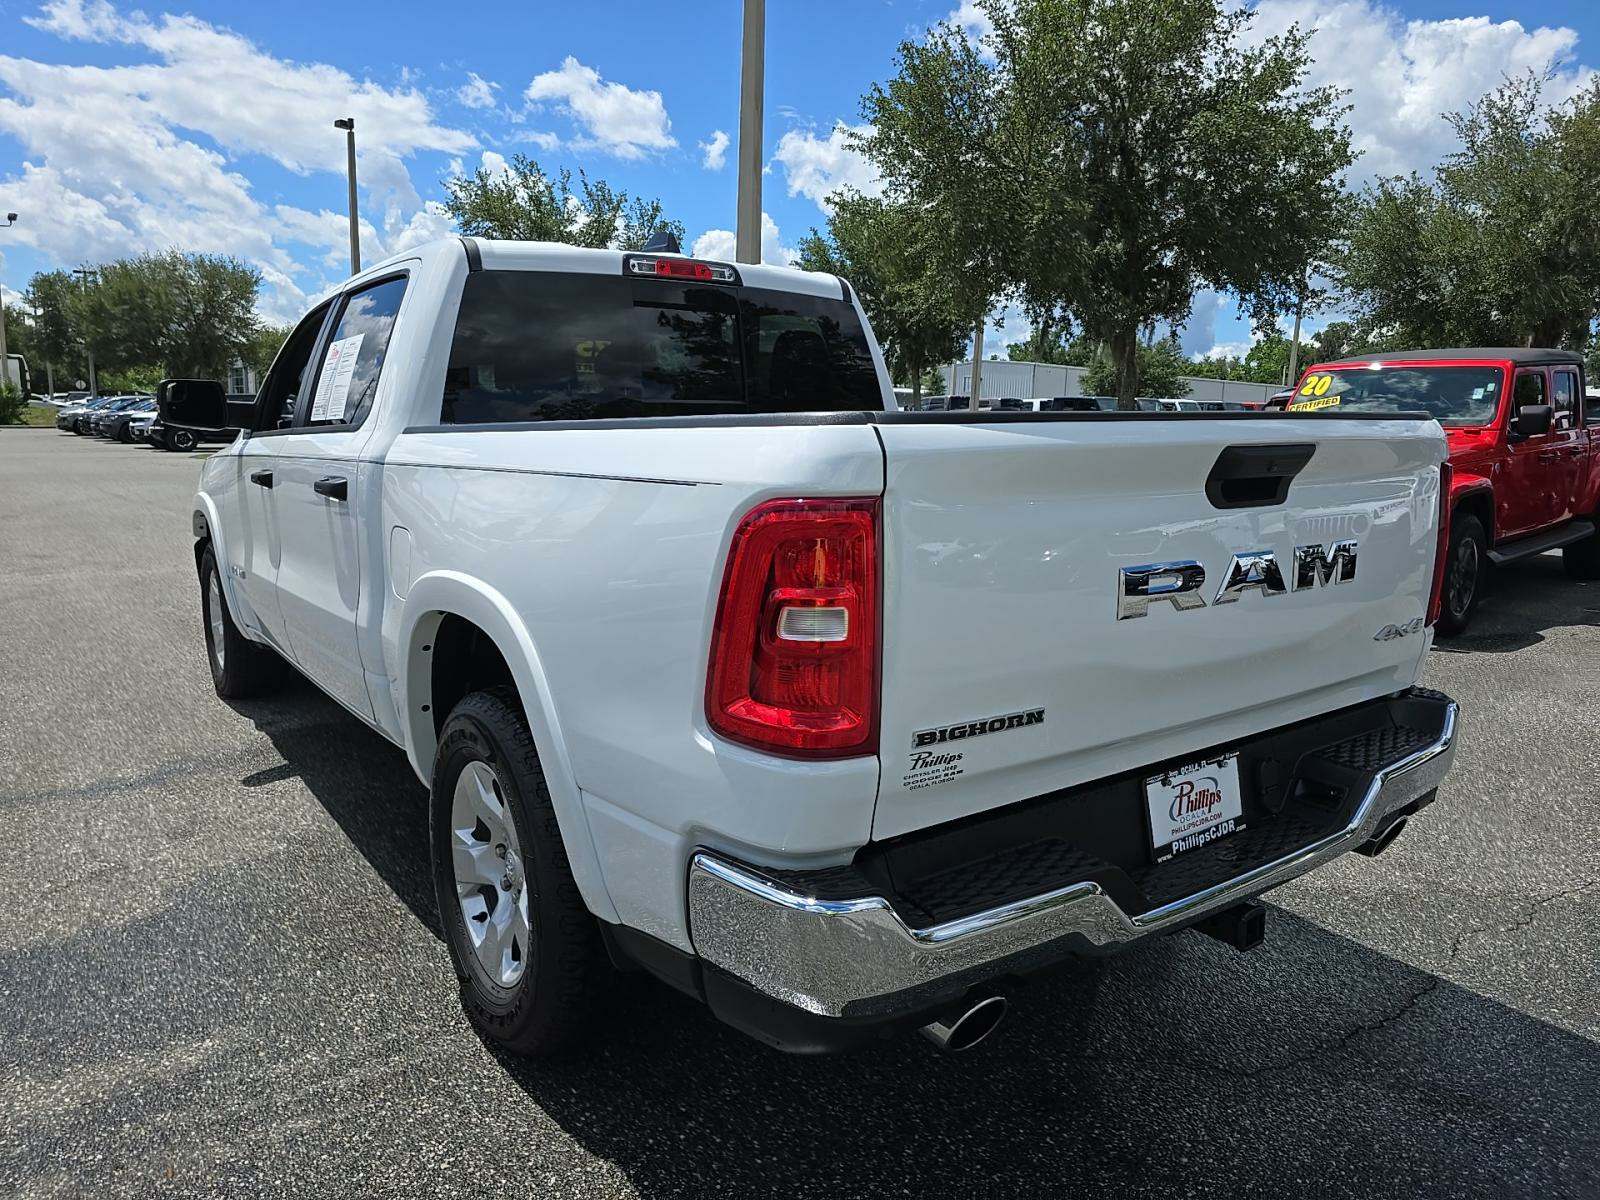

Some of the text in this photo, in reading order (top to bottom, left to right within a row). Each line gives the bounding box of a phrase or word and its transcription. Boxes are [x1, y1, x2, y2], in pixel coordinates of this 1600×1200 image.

[1301, 375, 1332, 396] 20
[1290, 397, 1338, 411] CERTIFIED
[1116, 538, 1358, 621] RAM
[912, 707, 1045, 749] BIGHORN
[909, 751, 964, 771] Phillips
[903, 768, 941, 780] CHRYSLER
[903, 769, 964, 787] DODGE RAM
[1171, 780, 1222, 817] Phillips
[1171, 812, 1223, 836] PHILLIPSCJDR.COM
[1180, 809, 1207, 824] OCALA
